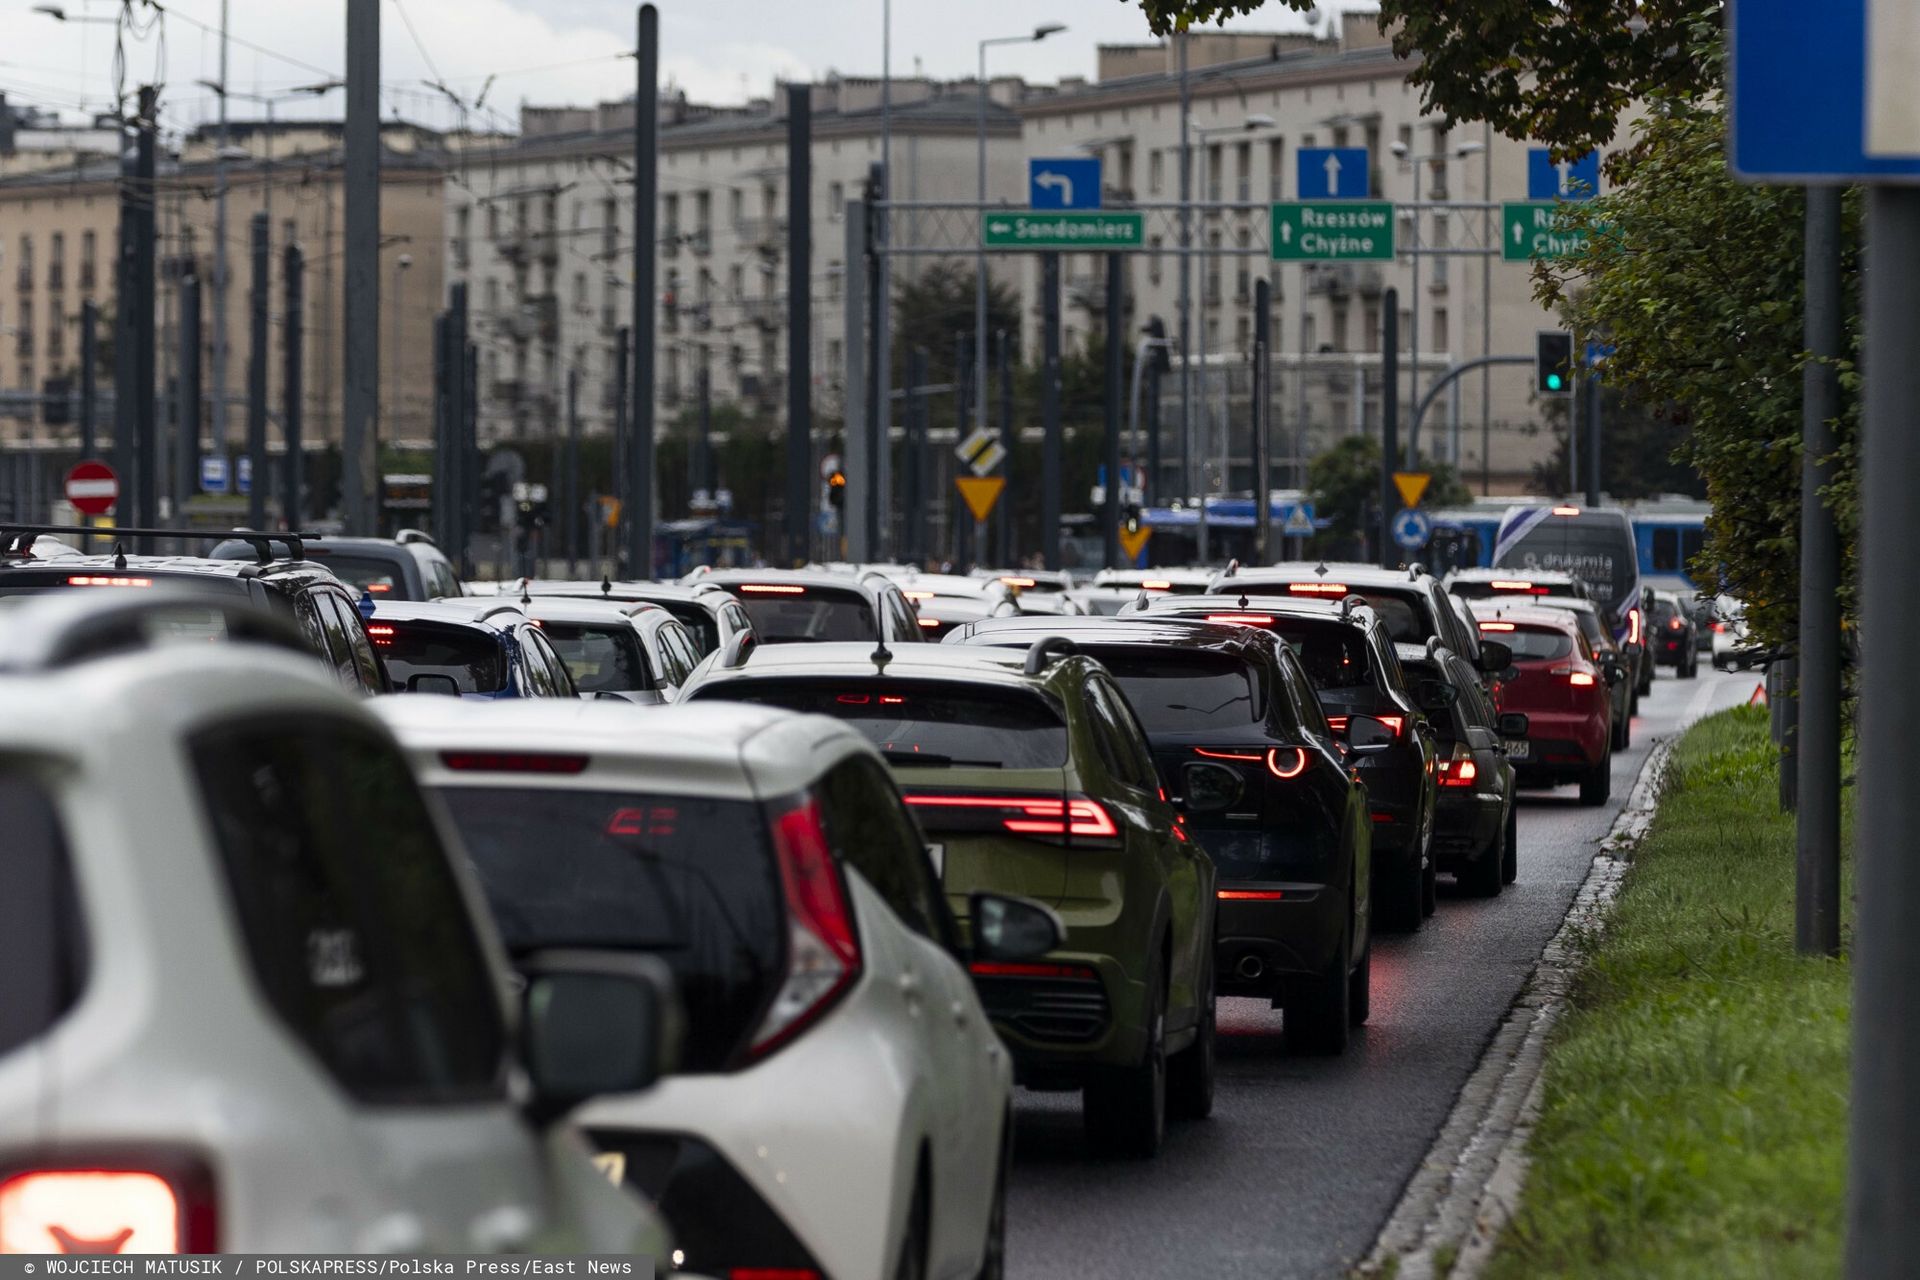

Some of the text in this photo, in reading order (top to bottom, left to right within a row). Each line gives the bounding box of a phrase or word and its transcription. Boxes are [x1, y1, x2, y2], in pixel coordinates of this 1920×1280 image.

[1301, 207, 1386, 228] Rzeszów
[1015, 218, 1134, 239] Sandomierz
[1300, 232, 1374, 258] Chyżne
[1543, 552, 1613, 569] drukarnia
